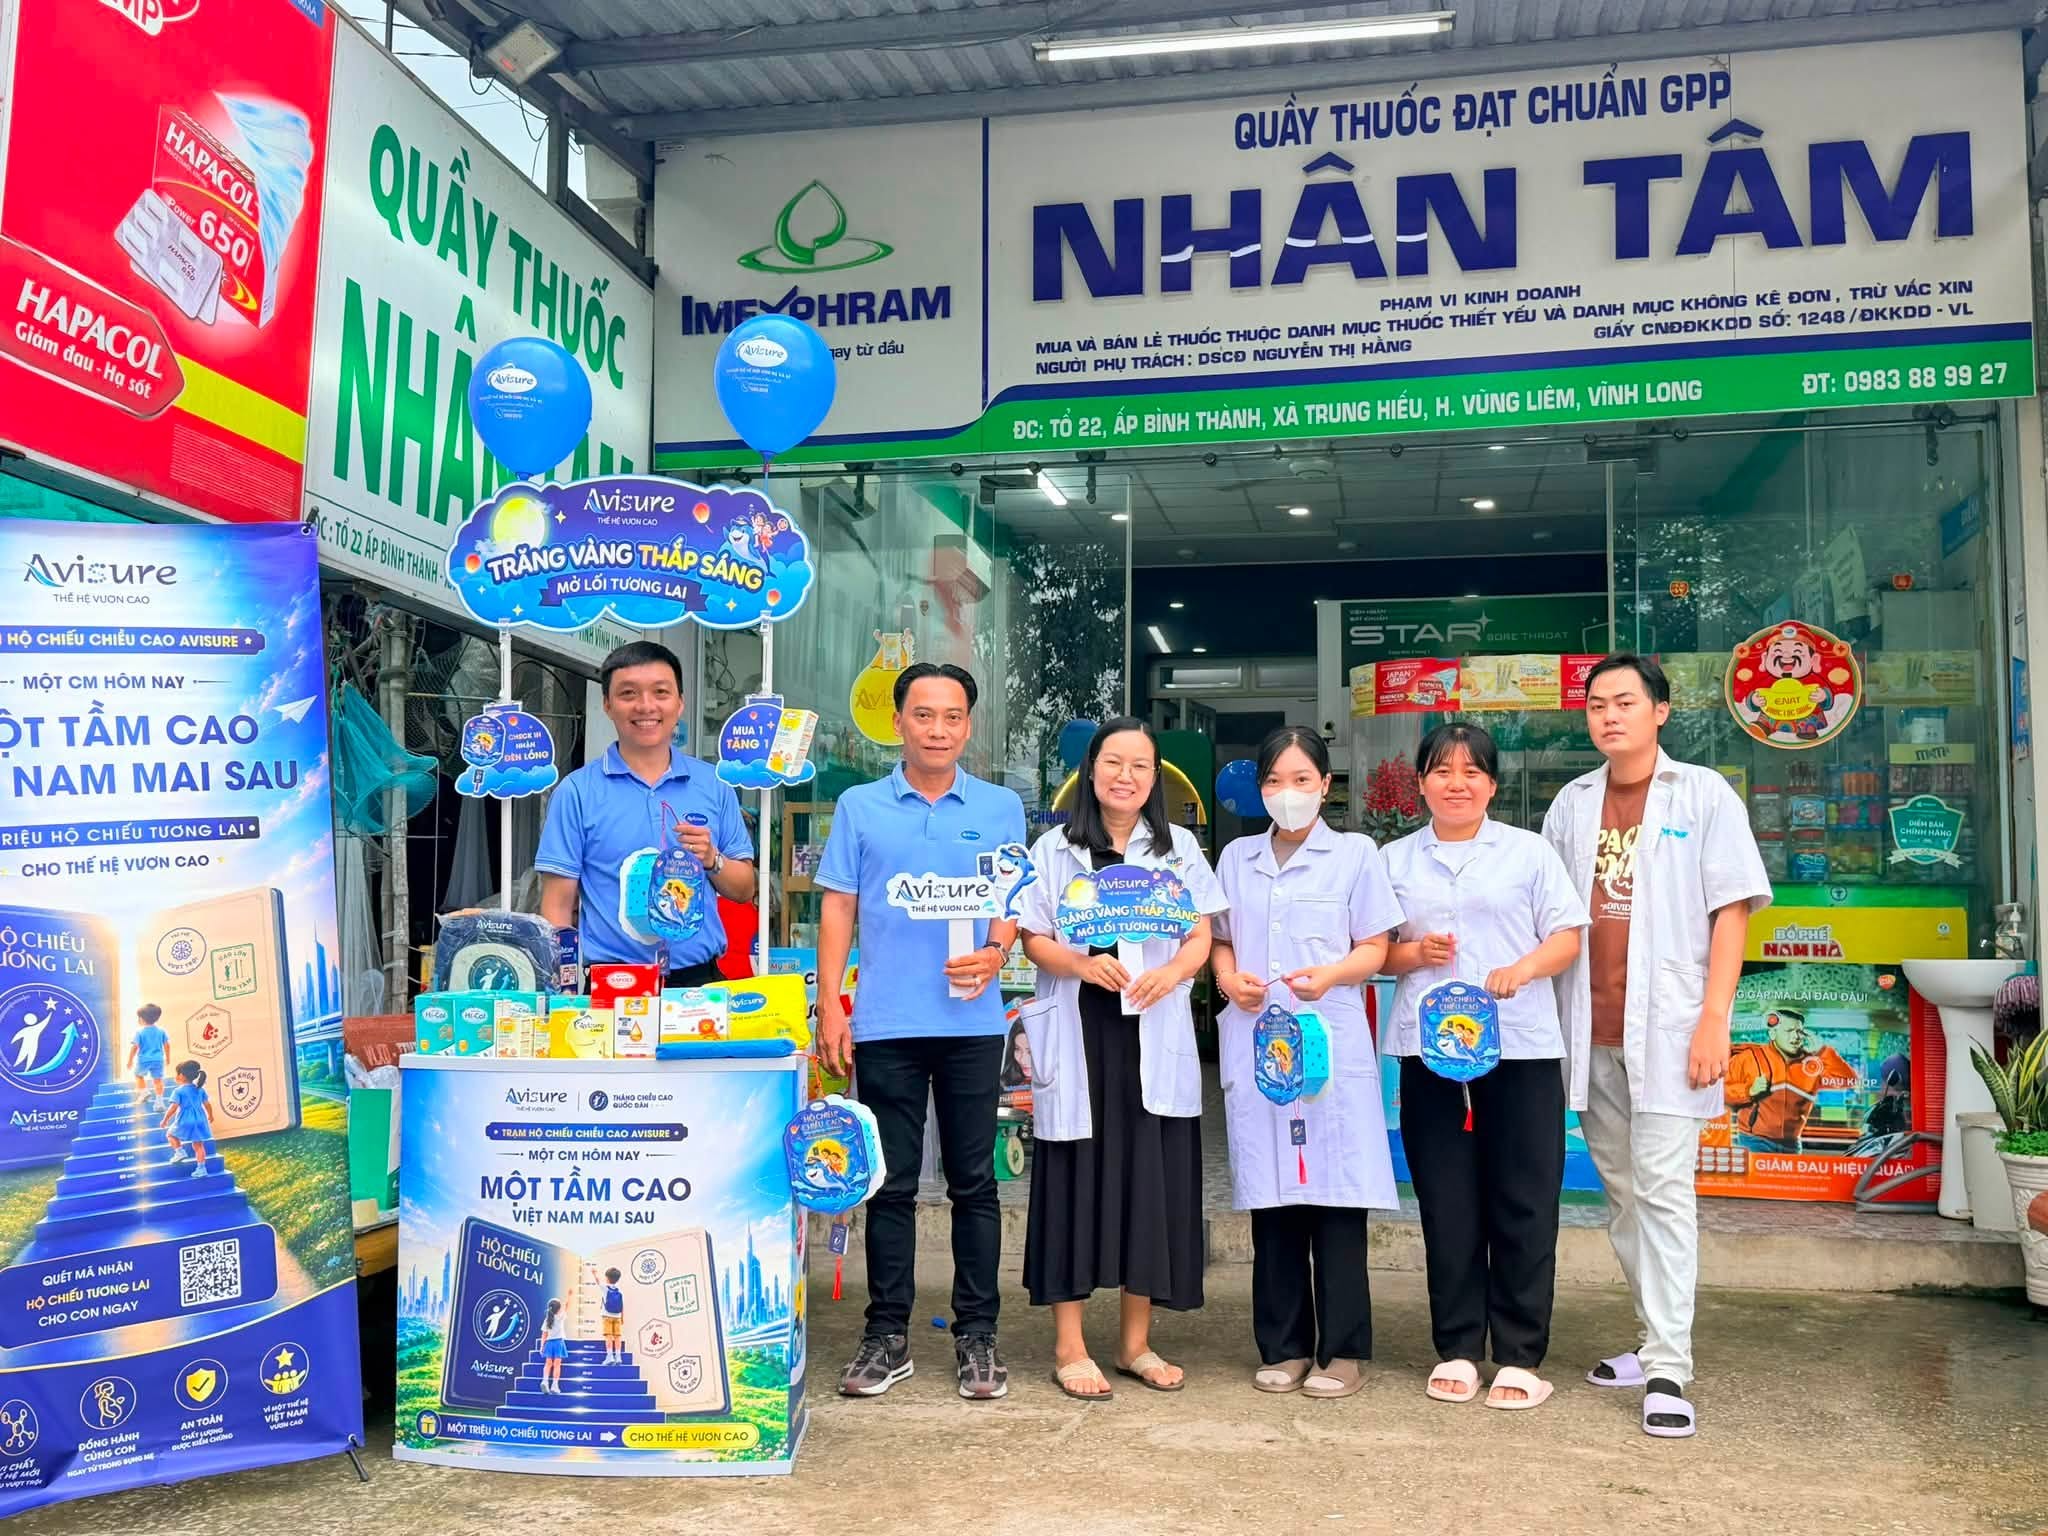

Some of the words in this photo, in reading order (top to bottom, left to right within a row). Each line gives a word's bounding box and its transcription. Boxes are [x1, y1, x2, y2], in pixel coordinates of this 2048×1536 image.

[1235, 92, 1318, 150] QUẦY
[1330, 83, 1441, 142] THUỐC
[1453, 89, 1516, 138] ĐẠT
[1528, 63, 1646, 124] CHUẨN
[1661, 70, 1732, 112] GPP
[165, 121, 254, 216] HAPACOL
[1033, 151, 1517, 302] NHÂN
[1583, 118, 1974, 262] TÂM
[166, 197, 196, 226] Power
[200, 211, 249, 266] 650
[370, 124, 500, 290] QUẦY
[509, 226, 626, 390] THUỐC
[1380, 296, 1432, 313] PHẠM
[1440, 294, 1457, 307] VI
[1464, 290, 1508, 306] KINH
[1516, 285, 1581, 301] DOANH
[16, 278, 163, 379] HAPACOL
[1035, 341, 1072, 355] MUA
[1076, 336, 1097, 352] VÀ
[1103, 332, 1137, 350] BÁN
[1168, 326, 1222, 346] THUỐC
[1226, 326, 1281, 344] THUỘC
[1287, 324, 1335, 339] DANH
[1342, 320, 1382, 338] MỤC
[1387, 310, 1444, 332] THUỐC
[1449, 307, 1497, 328] THIẾT
[1503, 302, 1537, 324] YẾU
[1544, 304, 1567, 321] VÀ
[1573, 303, 1624, 319] DANH
[1633, 298, 1674, 316] MỤC
[1681, 294, 1747, 311] KHÔNG
[1755, 289, 1781, 306] KÊ
[1849, 282, 1888, 300] TRỪ
[1939, 280, 1973, 295] XIN
[1593, 319, 1635, 339] GIẤY
[1949, 302, 1973, 316] VL
[15, 321, 59, 356] Giảm
[63, 344, 94, 372] đau
[104, 362, 126, 388] Hạ
[128, 375, 153, 399] sốt
[857, 341, 873, 357] từ
[878, 340, 905, 356] đầu
[1094, 357, 1126, 373] PHỤ
[1329, 343, 1355, 359] THỊ
[494, 374, 534, 385] Avisure
[1802, 372, 1836, 395] ĐT:
[1844, 369, 1900, 393] 0983
[1908, 367, 1937, 389] 88
[1943, 365, 1973, 387] 99
[1980, 362, 2008, 385] 27
[334, 276, 515, 527] NHÂ
[1013, 419, 1044, 440] ĐC:
[1050, 407, 1073, 438] TỔ
[1078, 417, 1107, 438] 22,
[1113, 405, 1139, 434] ẤP
[1144, 407, 1190, 434] BÌNH
[1196, 403, 1266, 432] THÀNH,
[1273, 401, 1299, 427] XÃ
[1304, 399, 1371, 426] TRUNG
[1377, 389, 1428, 421] HIẾU,
[1435, 396, 1455, 417] H.
[1462, 388, 1520, 416] VŨNG
[1526, 385, 1581, 412] LIÊM,
[1587, 380, 1639, 407] VĨNH
[1645, 379, 1702, 404] LONG
[583, 487, 675, 514] Avisure
[335, 517, 349, 549] TỔ
[351, 529, 362, 555] 22
[365, 528, 378, 561] ẤP
[380, 537, 405, 571] BÌNH
[407, 551, 438, 583] THÀNH
[488, 543, 565, 582] TRĂNG
[569, 535, 633, 567] VÀNG
[638, 534, 698, 571] THẤP
[701, 552, 763, 590] SÁNG
[24, 553, 178, 588] Avisure
[557, 575, 582, 595] MỞ
[584, 572, 607, 591] LỐI
[611, 577, 662, 594] TƯƠNG
[664, 583, 687, 600] LAI
[7, 629, 32, 650] HỘ
[37, 629, 86, 647] CHIẾU
[140, 634, 175, 648] CAO
[180, 635, 239, 648] AVISURE
[1350, 623, 1481, 645] STAR
[1521, 631, 1568, 641] THROAT
[23, 672, 63, 693] MỘT
[68, 676, 98, 689] CM
[104, 672, 146, 689] HÔM
[152, 675, 186, 689] NAY
[0, 708, 45, 758] ỘT
[58, 700, 151, 748] TẦM
[166, 714, 259, 745] CAO
[733, 726, 755, 735] MUA
[759, 726, 763, 735] 1
[726, 736, 760, 752] TẶNG
[764, 739, 769, 748] 1
[13, 763, 116, 797] NAM
[132, 762, 210, 794] MAI
[225, 760, 298, 792] SAU
[896, 879, 989, 902] Avisure
[1097, 878, 1149, 890] Avisure
[911, 903, 926, 912] THẾ
[928, 904, 938, 913] HỆ
[963, 904, 980, 912] CAO
[476, 920, 513, 930] Avisure
[1763, 943, 1809, 957] NAM
[1812, 940, 1843, 957] HÀ
[505, 1088, 567, 1104] Avisure
[502, 1129, 526, 1139] TRẠM
[529, 1127, 543, 1139] HỘ
[545, 1126, 573, 1138] CHIẾU
[606, 1130, 629, 1139] CAO
[631, 1129, 671, 1139] AVISURE
[1756, 1158, 1793, 1172] GIẢM
[1797, 1160, 1829, 1174] ĐAU
[481, 1170, 541, 1207] MỘT
[550, 1165, 611, 1201] TẦM
[622, 1177, 691, 1201] CAO
[512, 1207, 543, 1227] VIỆT
[550, 1211, 583, 1223] NAM
[589, 1211, 619, 1223] MAI
[625, 1211, 655, 1224] SAU
[42, 1268, 73, 1287] QUÉT
[76, 1263, 95, 1281] MÃ
[98, 1261, 133, 1280] NHẬN
[26, 1295, 45, 1311] HỘ
[48, 1285, 84, 1306] CHIẾU
[87, 1281, 129, 1300] TƯƠNG
[132, 1279, 150, 1291] LAI
[38, 1312, 67, 1327] CHO
[70, 1307, 99, 1322] CON
[103, 1301, 139, 1318] NGAY
[181, 1421, 195, 1430] AN
[196, 1414, 223, 1428] TOÀN
[264, 1412, 286, 1424] VIỆT
[287, 1408, 308, 1420] NAM
